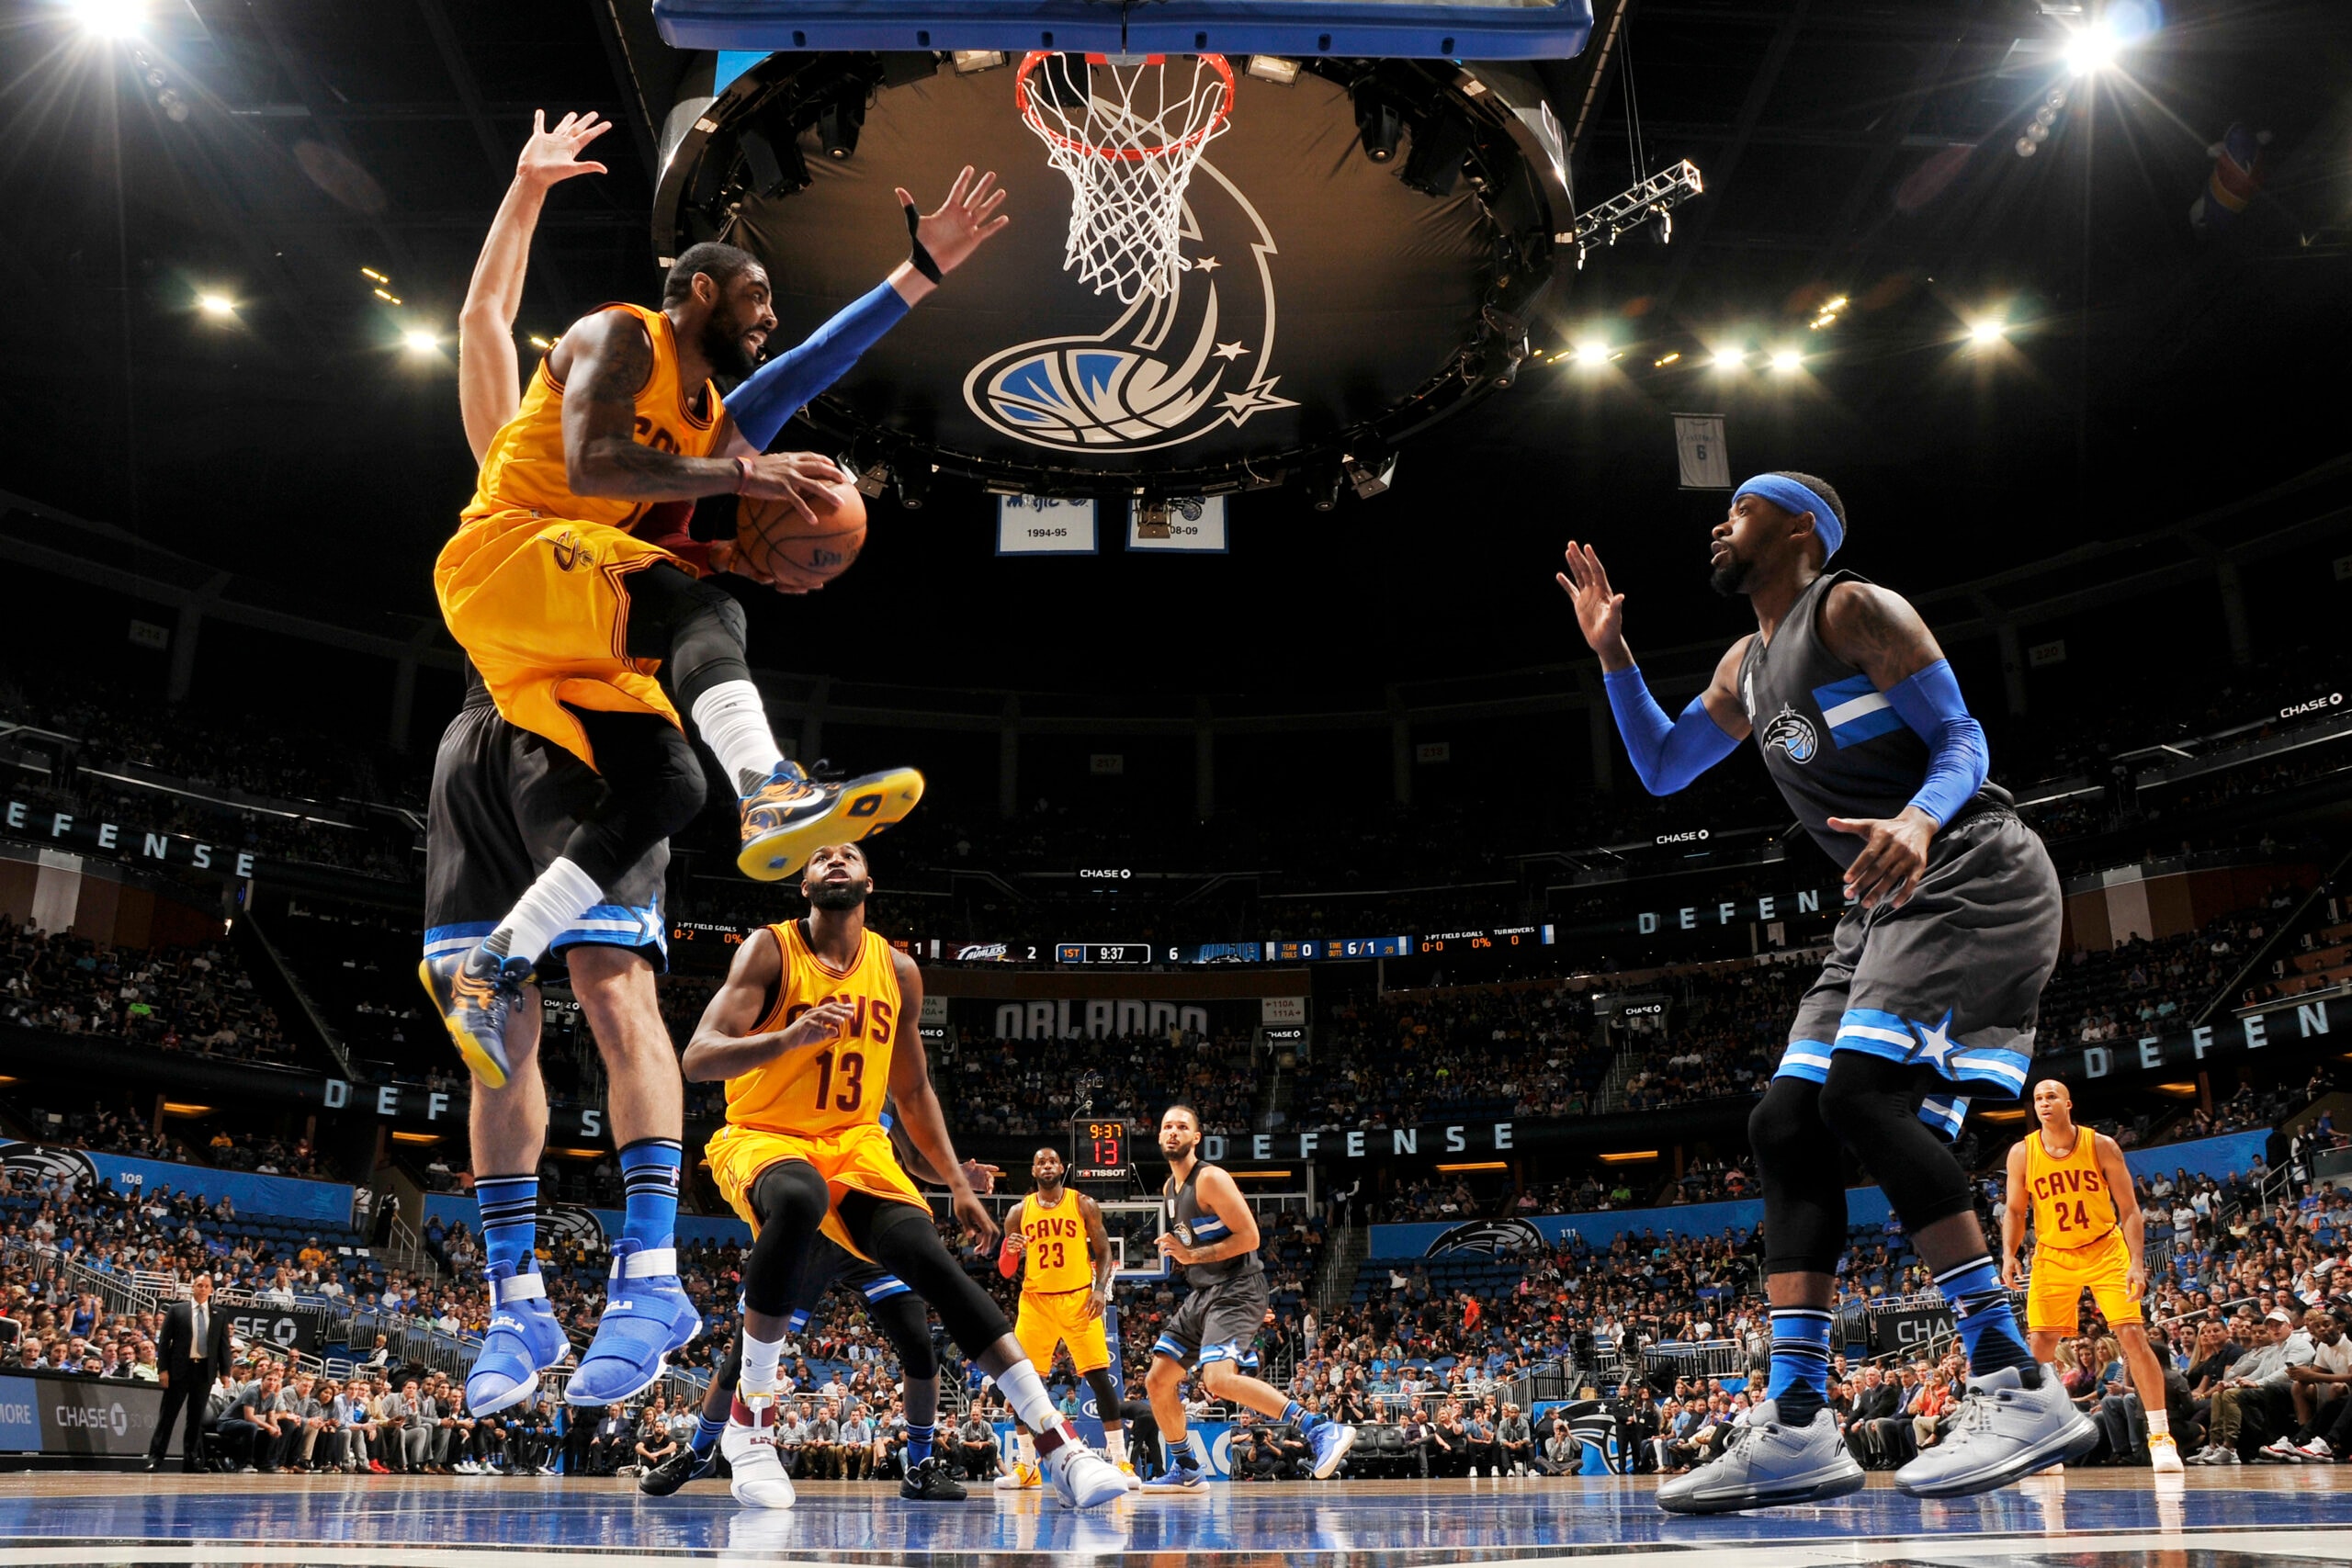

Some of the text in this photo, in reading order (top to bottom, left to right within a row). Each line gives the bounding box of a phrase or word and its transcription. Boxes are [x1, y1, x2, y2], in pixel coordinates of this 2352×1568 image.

[1027, 529, 1068, 537] 1994-95
[1170, 526, 1198, 535] 08-09
[2280, 696, 2329, 718] CHASE
[1657, 831, 1697, 844] CHASE
[1080, 869, 1119, 878] CHASE
[1638, 885, 1860, 935] DEFENS
[715, 924, 737, 932] GOALS
[1493, 926, 1535, 935] TURNOVERS
[673, 929, 695, 941] 0-2
[1472, 937, 1491, 948] 0%
[1510, 935, 1519, 945] 0
[914, 942, 922, 955] 1
[1027, 946, 1036, 959] 2
[1063, 948, 1125, 960] 1ST 9:37
[1169, 947, 1179, 961] 6
[1302, 943, 1312, 957] 0
[544, 999, 571, 1010] CHAE
[1625, 1006, 1653, 1015] CHASE
[995, 999, 1207, 1041] ORLANDO
[815, 1049, 865, 1112] 13
[1090, 1123, 1122, 1139] 9:37
[1204, 1122, 1513, 1161] DEFENSE
[1094, 1139, 1118, 1166] 13
[120, 1172, 143, 1185] 108
[1091, 1168, 1126, 1177] TISSOT
[2034, 1169, 2099, 1201] CAVS
[2055, 1200, 2089, 1233] 24
[1025, 1218, 1077, 1243] CAVS
[1560, 1228, 1577, 1237] 111
[1038, 1242, 1065, 1269] 23
[1897, 1318, 1957, 1343] CHA
[56, 1405, 108, 1429] CHASE
